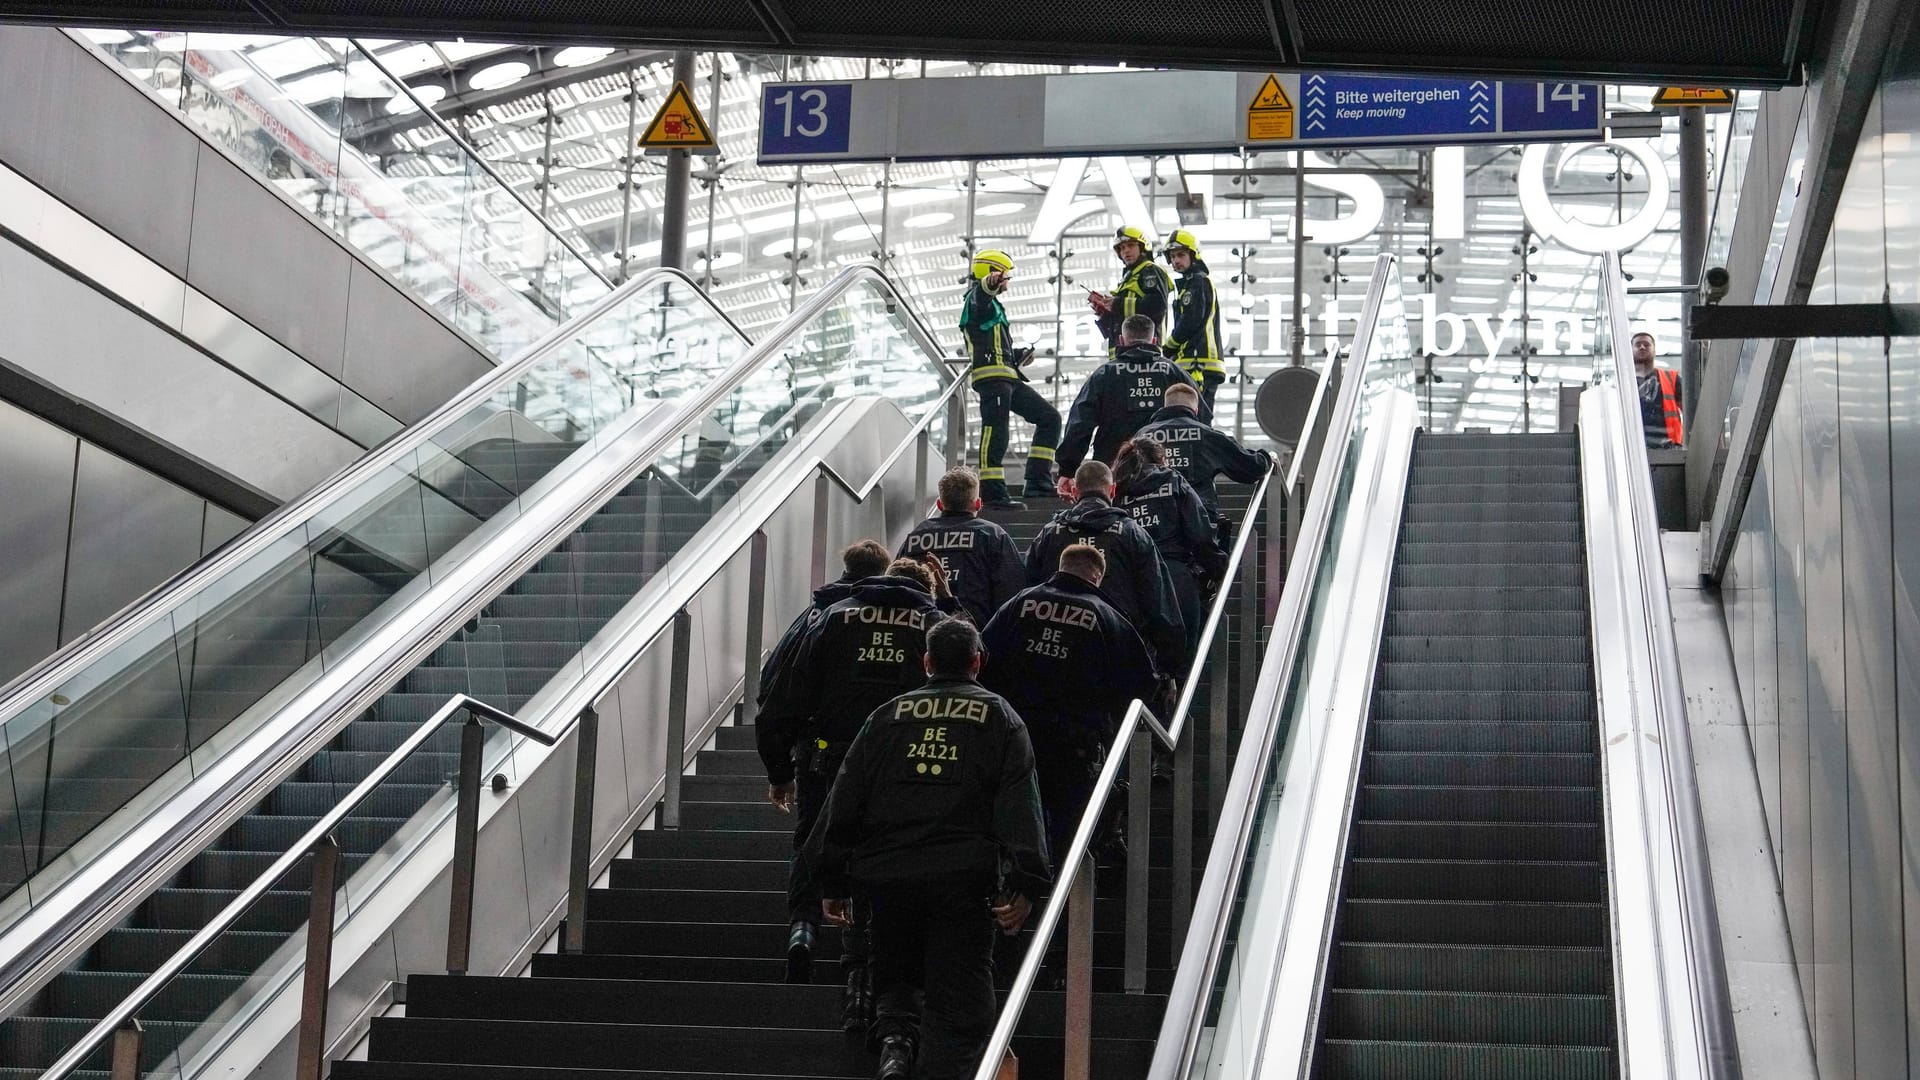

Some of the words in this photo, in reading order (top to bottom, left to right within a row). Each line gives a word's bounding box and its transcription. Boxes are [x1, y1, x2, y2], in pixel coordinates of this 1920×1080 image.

[1335, 91, 1369, 104] Bitte
[1372, 88, 1460, 104] weitergehen
[774, 89, 828, 138] 13
[1335, 107, 1363, 120] Keep
[1366, 106, 1406, 118] moving
[1416, 292, 1518, 373] by
[1138, 377, 1153, 387] BE
[1129, 387, 1161, 397] 24120
[1165, 447, 1181, 457] BE
[1164, 457, 1189, 467] 123
[1133, 504, 1149, 518] BE
[1135, 514, 1160, 528] 124
[907, 531, 975, 553] POLIZEI
[1079, 536, 1096, 548] BE
[844, 605, 925, 631] POLIZEI
[1020, 599, 1097, 631] POLIZEI
[872, 631, 894, 646] BE
[1042, 627, 1063, 643] BE
[857, 647, 905, 663] 24126
[1025, 639, 1069, 659] 24135
[894, 697, 989, 723] POLIZEI
[923, 727, 947, 742] BE
[906, 743, 958, 761] 24121
